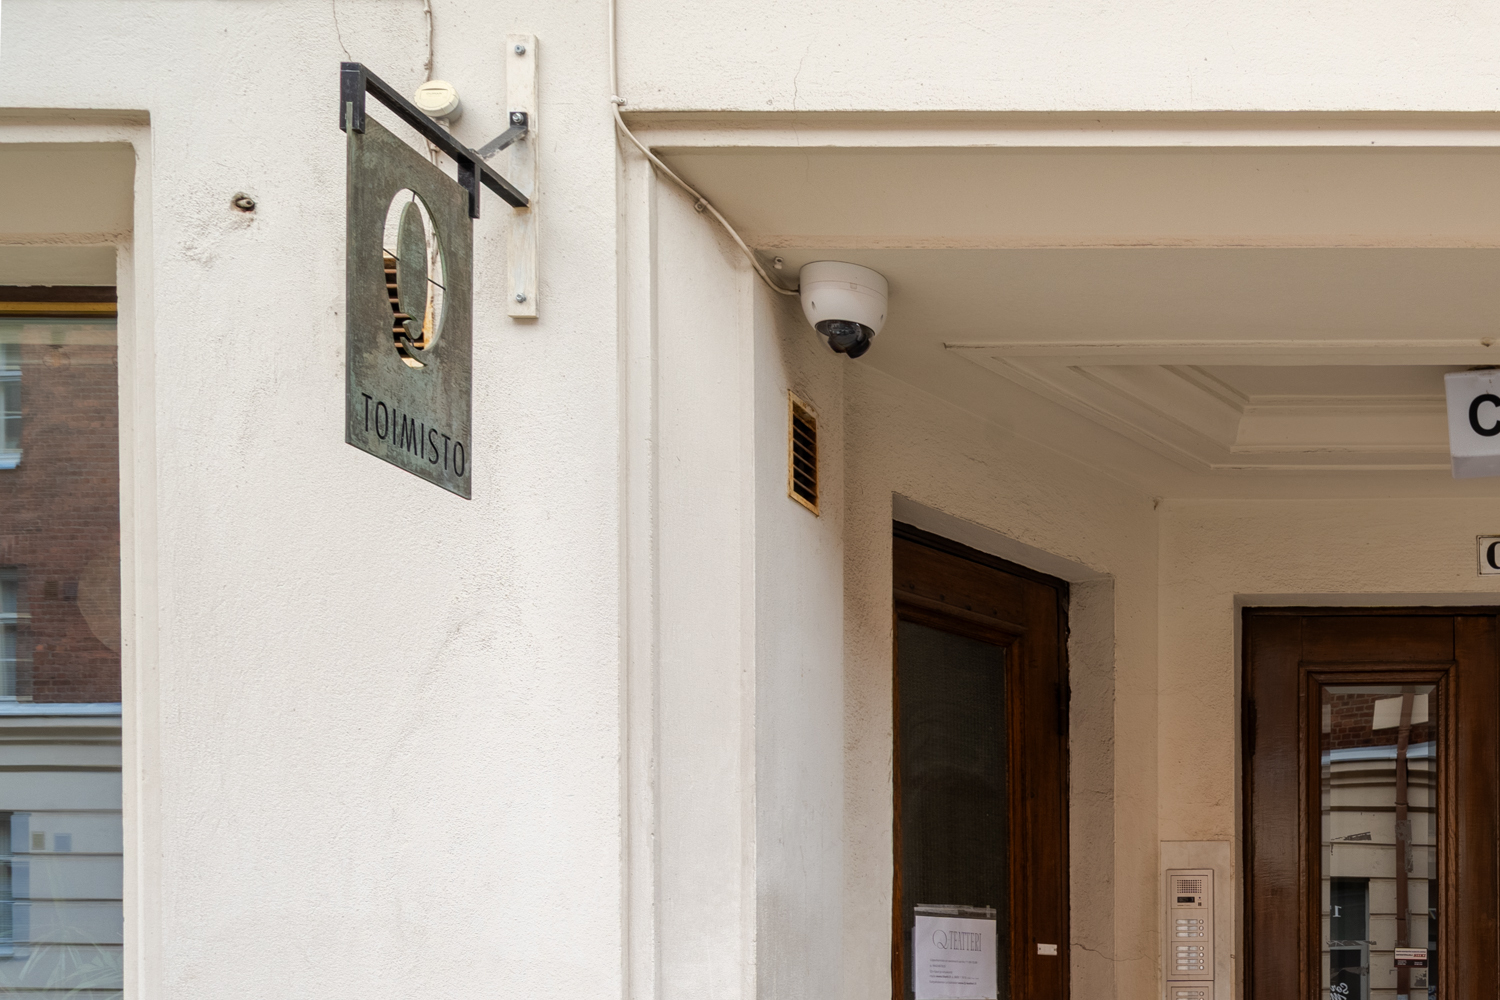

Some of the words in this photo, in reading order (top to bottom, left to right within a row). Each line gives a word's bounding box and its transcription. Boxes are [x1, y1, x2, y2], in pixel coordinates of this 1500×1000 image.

[382, 188, 446, 369] Q
[362, 392, 465, 478] TOIMISTO
[932, 929, 982, 951] Q-TEATTERI
